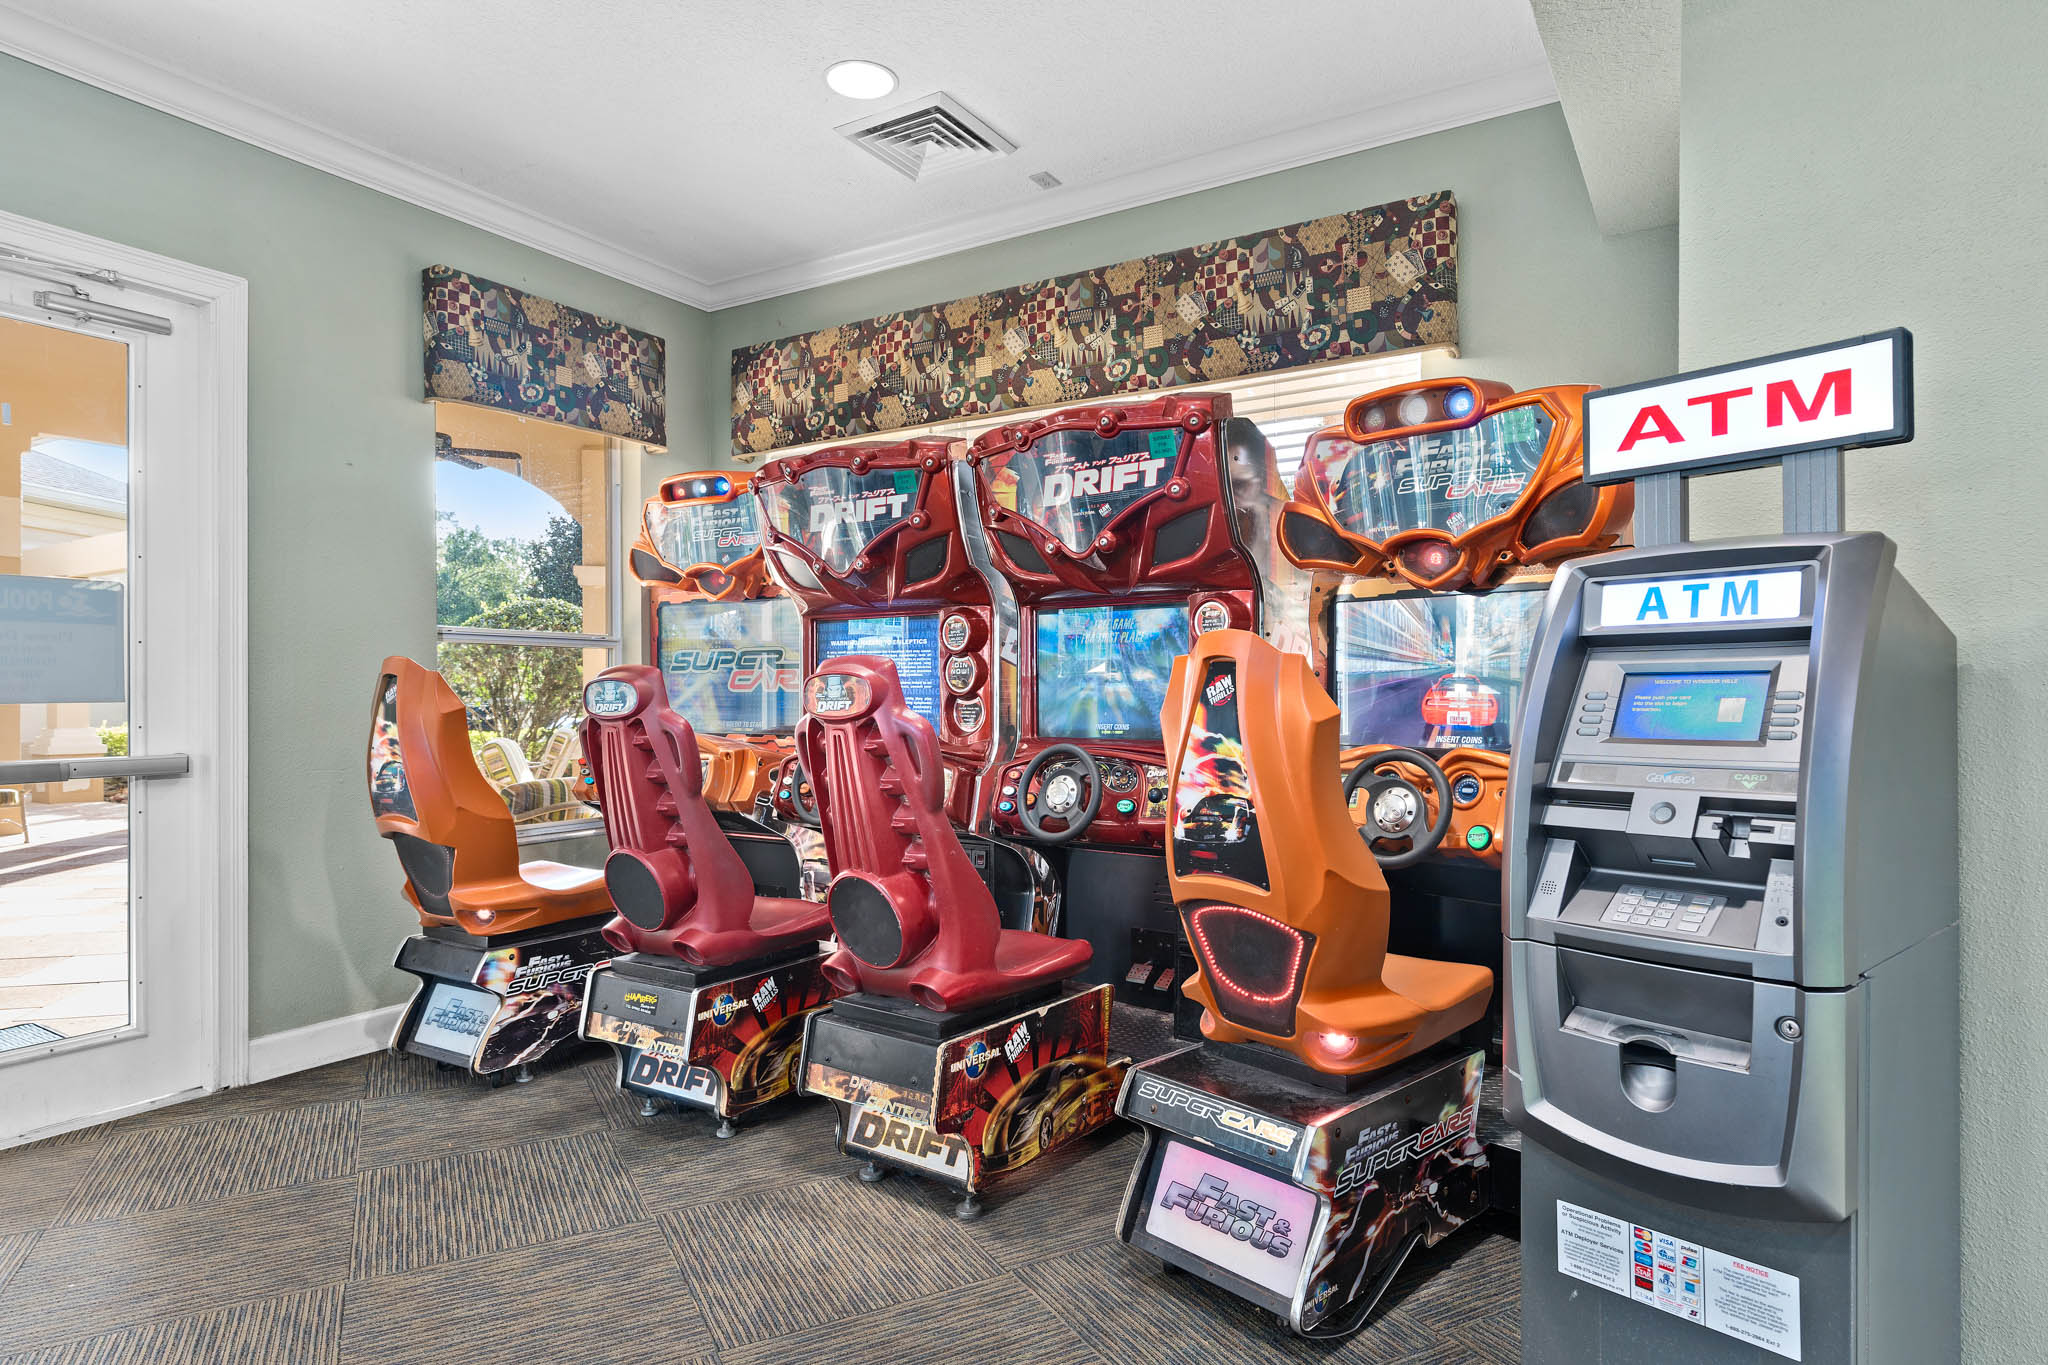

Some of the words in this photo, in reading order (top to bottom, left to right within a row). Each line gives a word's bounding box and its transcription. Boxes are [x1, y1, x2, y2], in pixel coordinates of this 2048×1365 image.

[1616, 367, 1852, 452] ATM
[1043, 458, 1166, 507] DRIFT
[810, 494, 908, 533] DRIFT
[1635, 579, 1759, 621] ATM
[1120, 631, 1144, 643] PLACE
[669, 646, 786, 674] SUPER
[728, 669, 800, 693] CAR
[1206, 674, 1233, 698] RAW
[596, 703, 624, 712] DRIFT
[816, 700, 852, 714] DRIFT
[1209, 685, 1235, 706] THRILLS
[1436, 735, 1460, 743] INSERT
[1461, 736, 1483, 744] COINS
[1646, 773, 1696, 785] GENMEGA
[1734, 774, 1768, 782] CARD
[514, 959, 573, 978] FURIOUS
[529, 955, 564, 968] FAST
[752, 976, 777, 1005] RAW
[756, 986, 779, 1013] THRILLS
[443, 998, 484, 1024] FAST
[480, 1015, 489, 1025] &
[698, 998, 749, 1022] UNIVERSAL
[1004, 1021, 1029, 1055] RAW
[1008, 1033, 1031, 1064] THRILLS
[950, 1046, 1002, 1073] UNIVERSAL
[631, 1054, 717, 1097] DRIFT
[852, 1110, 966, 1168] DRIFT
[1345, 1130, 1400, 1165] FURIOUS
[1358, 1125, 1392, 1148] FAST
[1192, 1172, 1276, 1228] FAST
[1273, 1218, 1292, 1237] &
[1562, 1205, 1594, 1220] Operational
[1594, 1216, 1622, 1228] Problems
[1160, 1180, 1292, 1258] FURIOUS
[1569, 1213, 1599, 1228] Suspicious
[1600, 1224, 1622, 1236] Activity
[1561, 1229, 1573, 1237] ATM
[1574, 1233, 1598, 1245] Deployer
[1600, 1242, 1624, 1254] Services
[1658, 1237, 1674, 1247] VISA
[1635, 1268, 1652, 1278] STAR
[1745, 1266, 1768, 1278] NOTICE
[1304, 1284, 1338, 1312] UNIVERSAL
